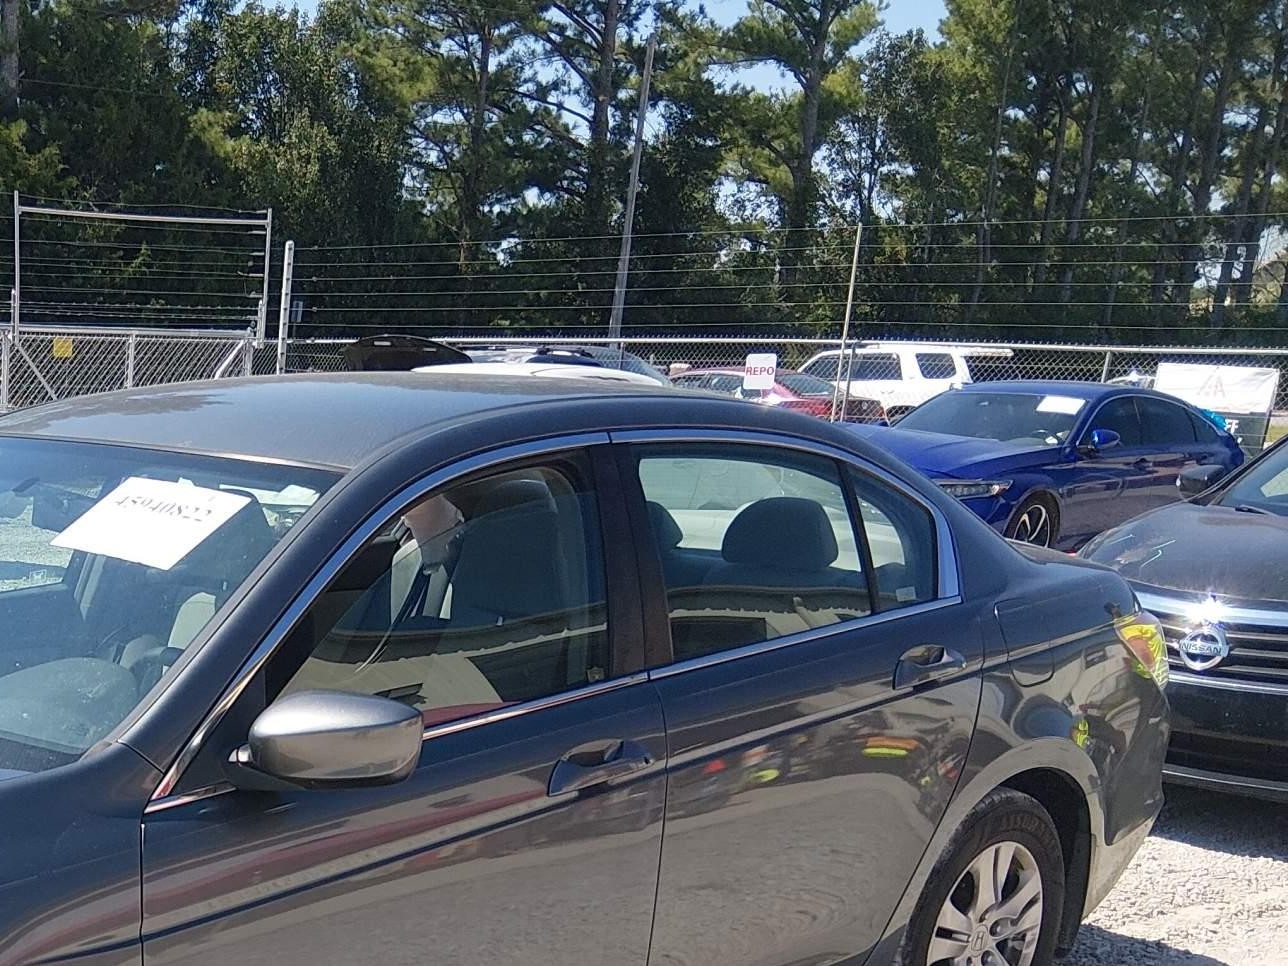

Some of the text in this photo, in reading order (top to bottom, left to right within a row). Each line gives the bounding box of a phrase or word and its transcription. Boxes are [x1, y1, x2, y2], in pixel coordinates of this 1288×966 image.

[745, 366, 775, 377] REPO
[114, 495, 214, 522] 45940822
[1179, 639, 1223, 655] NISSAN
